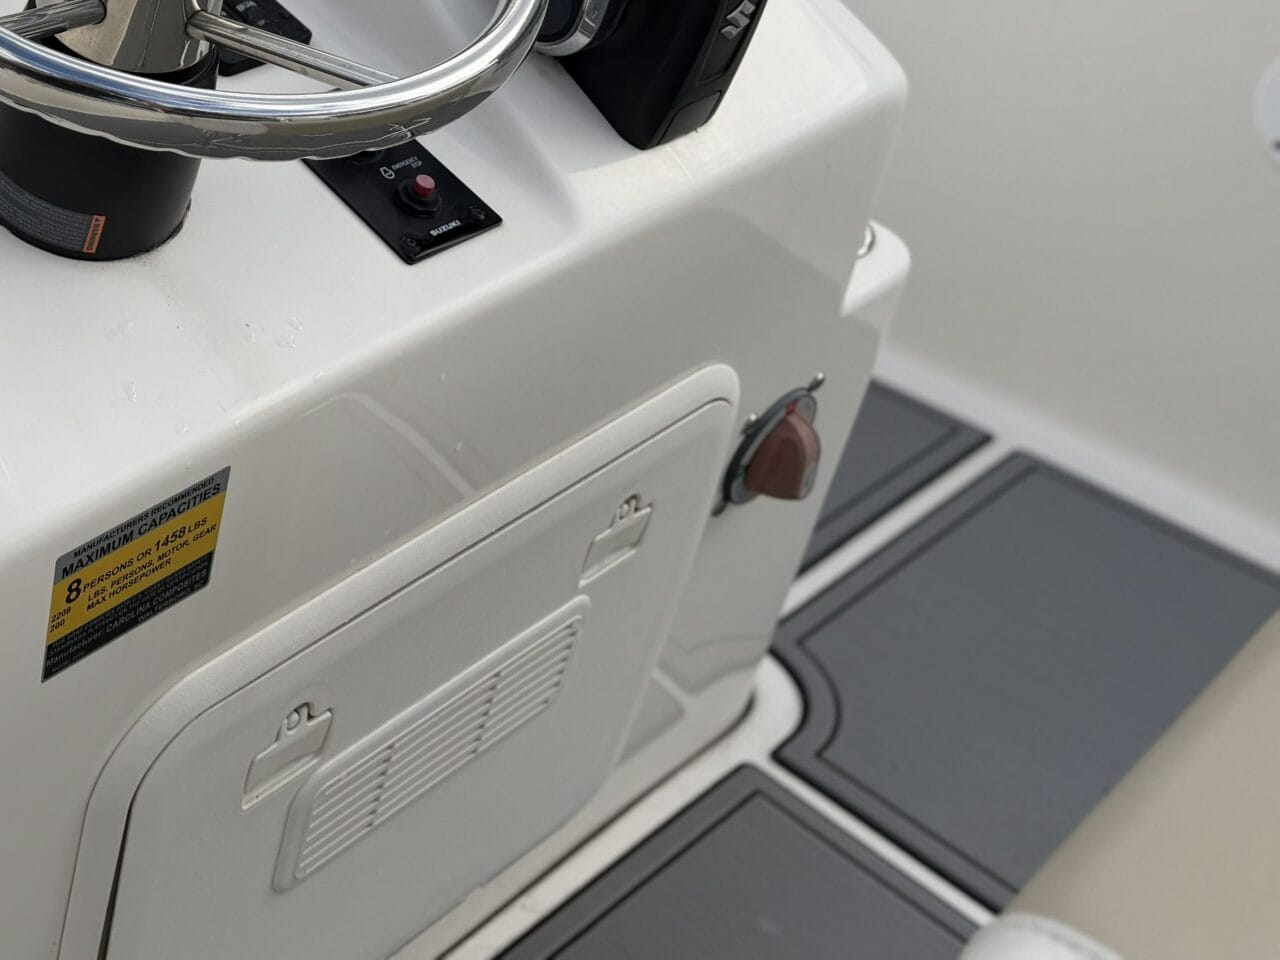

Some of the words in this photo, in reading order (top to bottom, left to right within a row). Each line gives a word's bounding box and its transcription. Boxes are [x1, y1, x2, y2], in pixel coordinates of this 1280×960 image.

[430, 219, 461, 237] SUZUKI
[62, 529, 133, 578] MAXIMUM
[137, 482, 221, 537] CAPACITIES
[73, 511, 148, 558] MANUFACTURERS
[151, 476, 214, 516] RECOMMENDED
[65, 575, 82, 605] 8
[82, 556, 134, 593] PERSONS
[136, 546, 151, 562] OR
[153, 525, 186, 552] 1458
[187, 515, 207, 533] LBS
[86, 593, 106, 611] MAX
[108, 556, 171, 599] HORSEPOWER
[110, 557, 154, 589] PERSONS,
[192, 522, 216, 542] GEAR
[106, 600, 150, 633] CAROLINA
